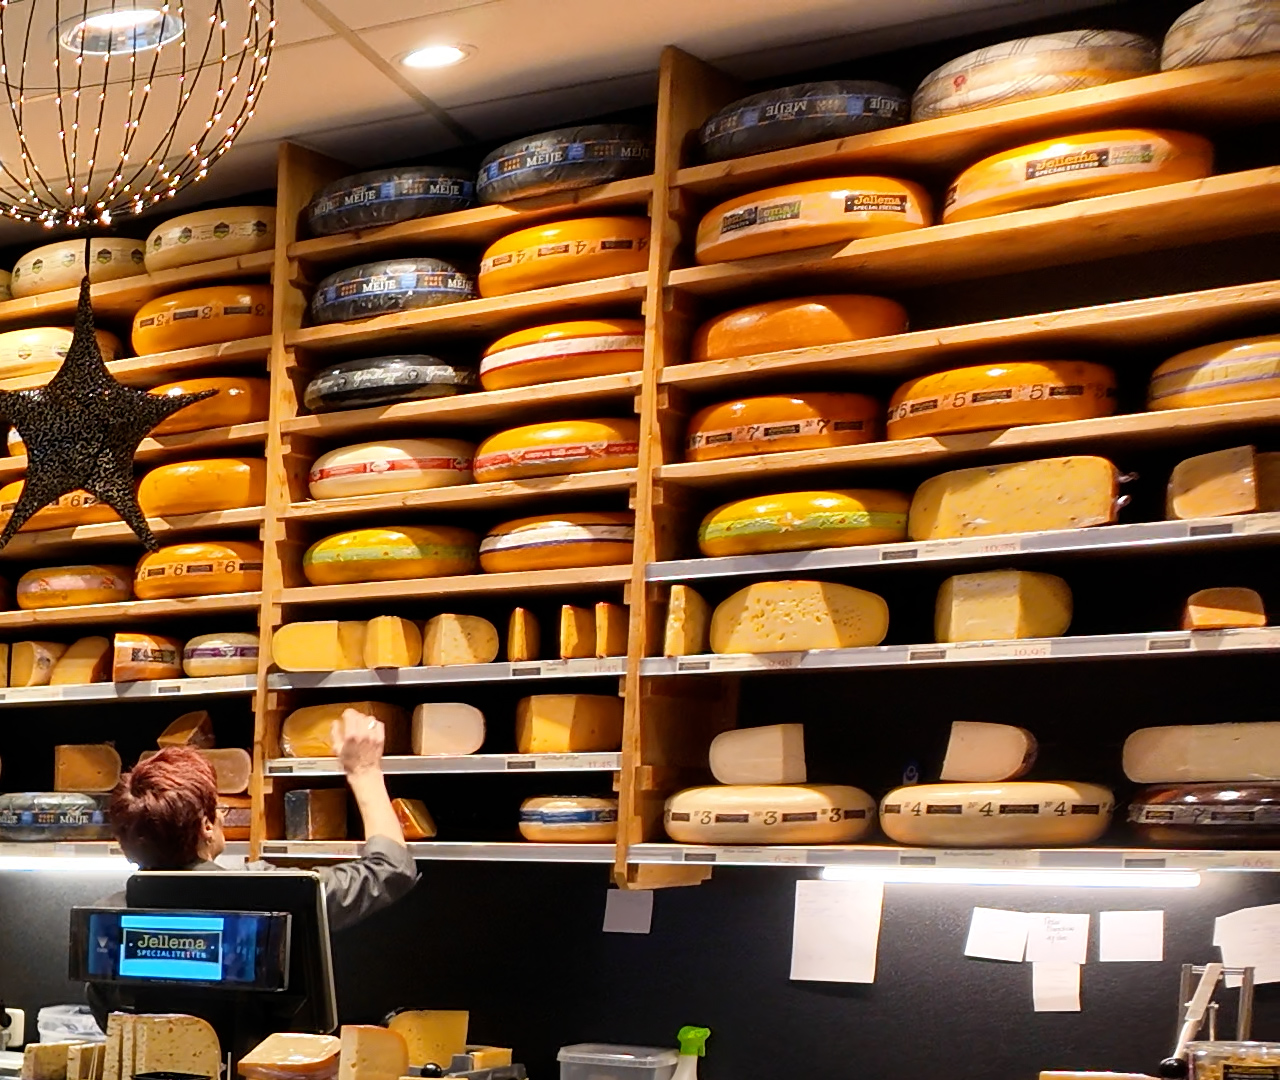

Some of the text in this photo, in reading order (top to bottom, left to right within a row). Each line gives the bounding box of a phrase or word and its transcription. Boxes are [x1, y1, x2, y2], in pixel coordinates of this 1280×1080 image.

[527, 151, 562, 167] MEIJE
[430, 184, 460, 197] MEIJE
[344, 191, 376, 206] MEIJE
[853, 195, 901, 205] Jellema
[362, 280, 397, 293] MEIJE
[1030, 384, 1043, 399] 5
[952, 391, 966, 407] 5
[747, 426, 760, 440] 7
[817, 419, 831, 434] 7
[174, 564, 184, 576] 6
[224, 561, 235, 573] 6
[829, 808, 841, 822] 3
[911, 802, 921, 816] 4
[979, 802, 994, 816] 4
[1054, 802, 1066, 816] 4
[700, 810, 711, 825] 3
[764, 811, 777, 825] 3
[137, 935, 207, 950] Jellema
